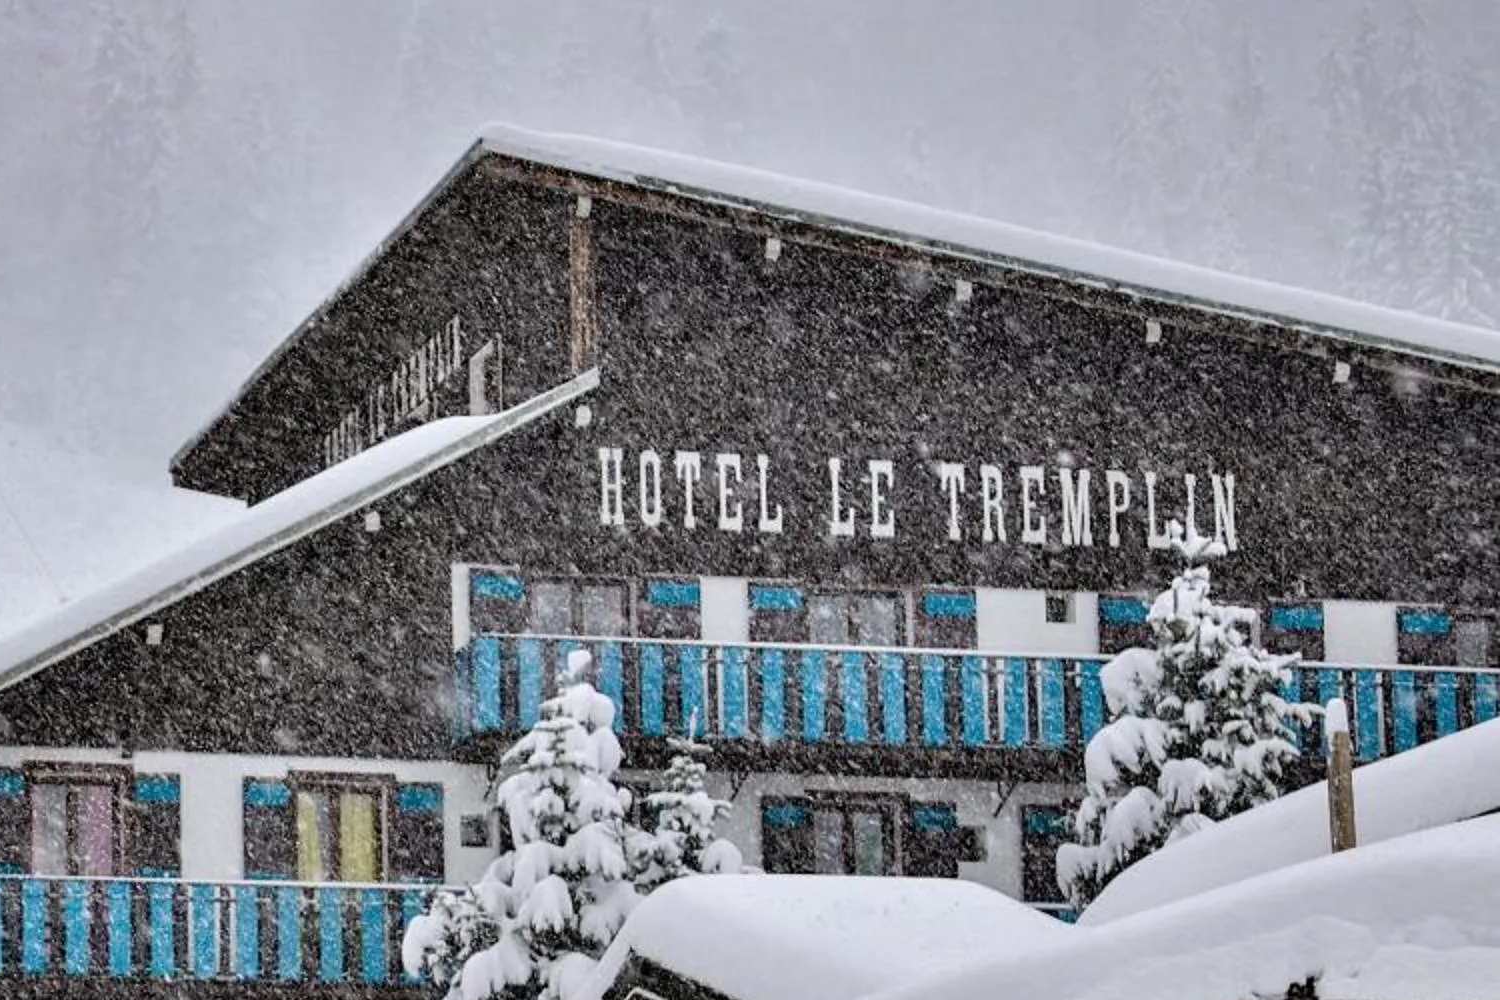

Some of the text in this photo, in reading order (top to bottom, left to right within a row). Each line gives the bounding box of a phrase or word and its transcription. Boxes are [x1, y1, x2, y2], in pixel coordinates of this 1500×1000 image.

[598, 446, 1239, 552] HOTEL LE TREMPLIN
